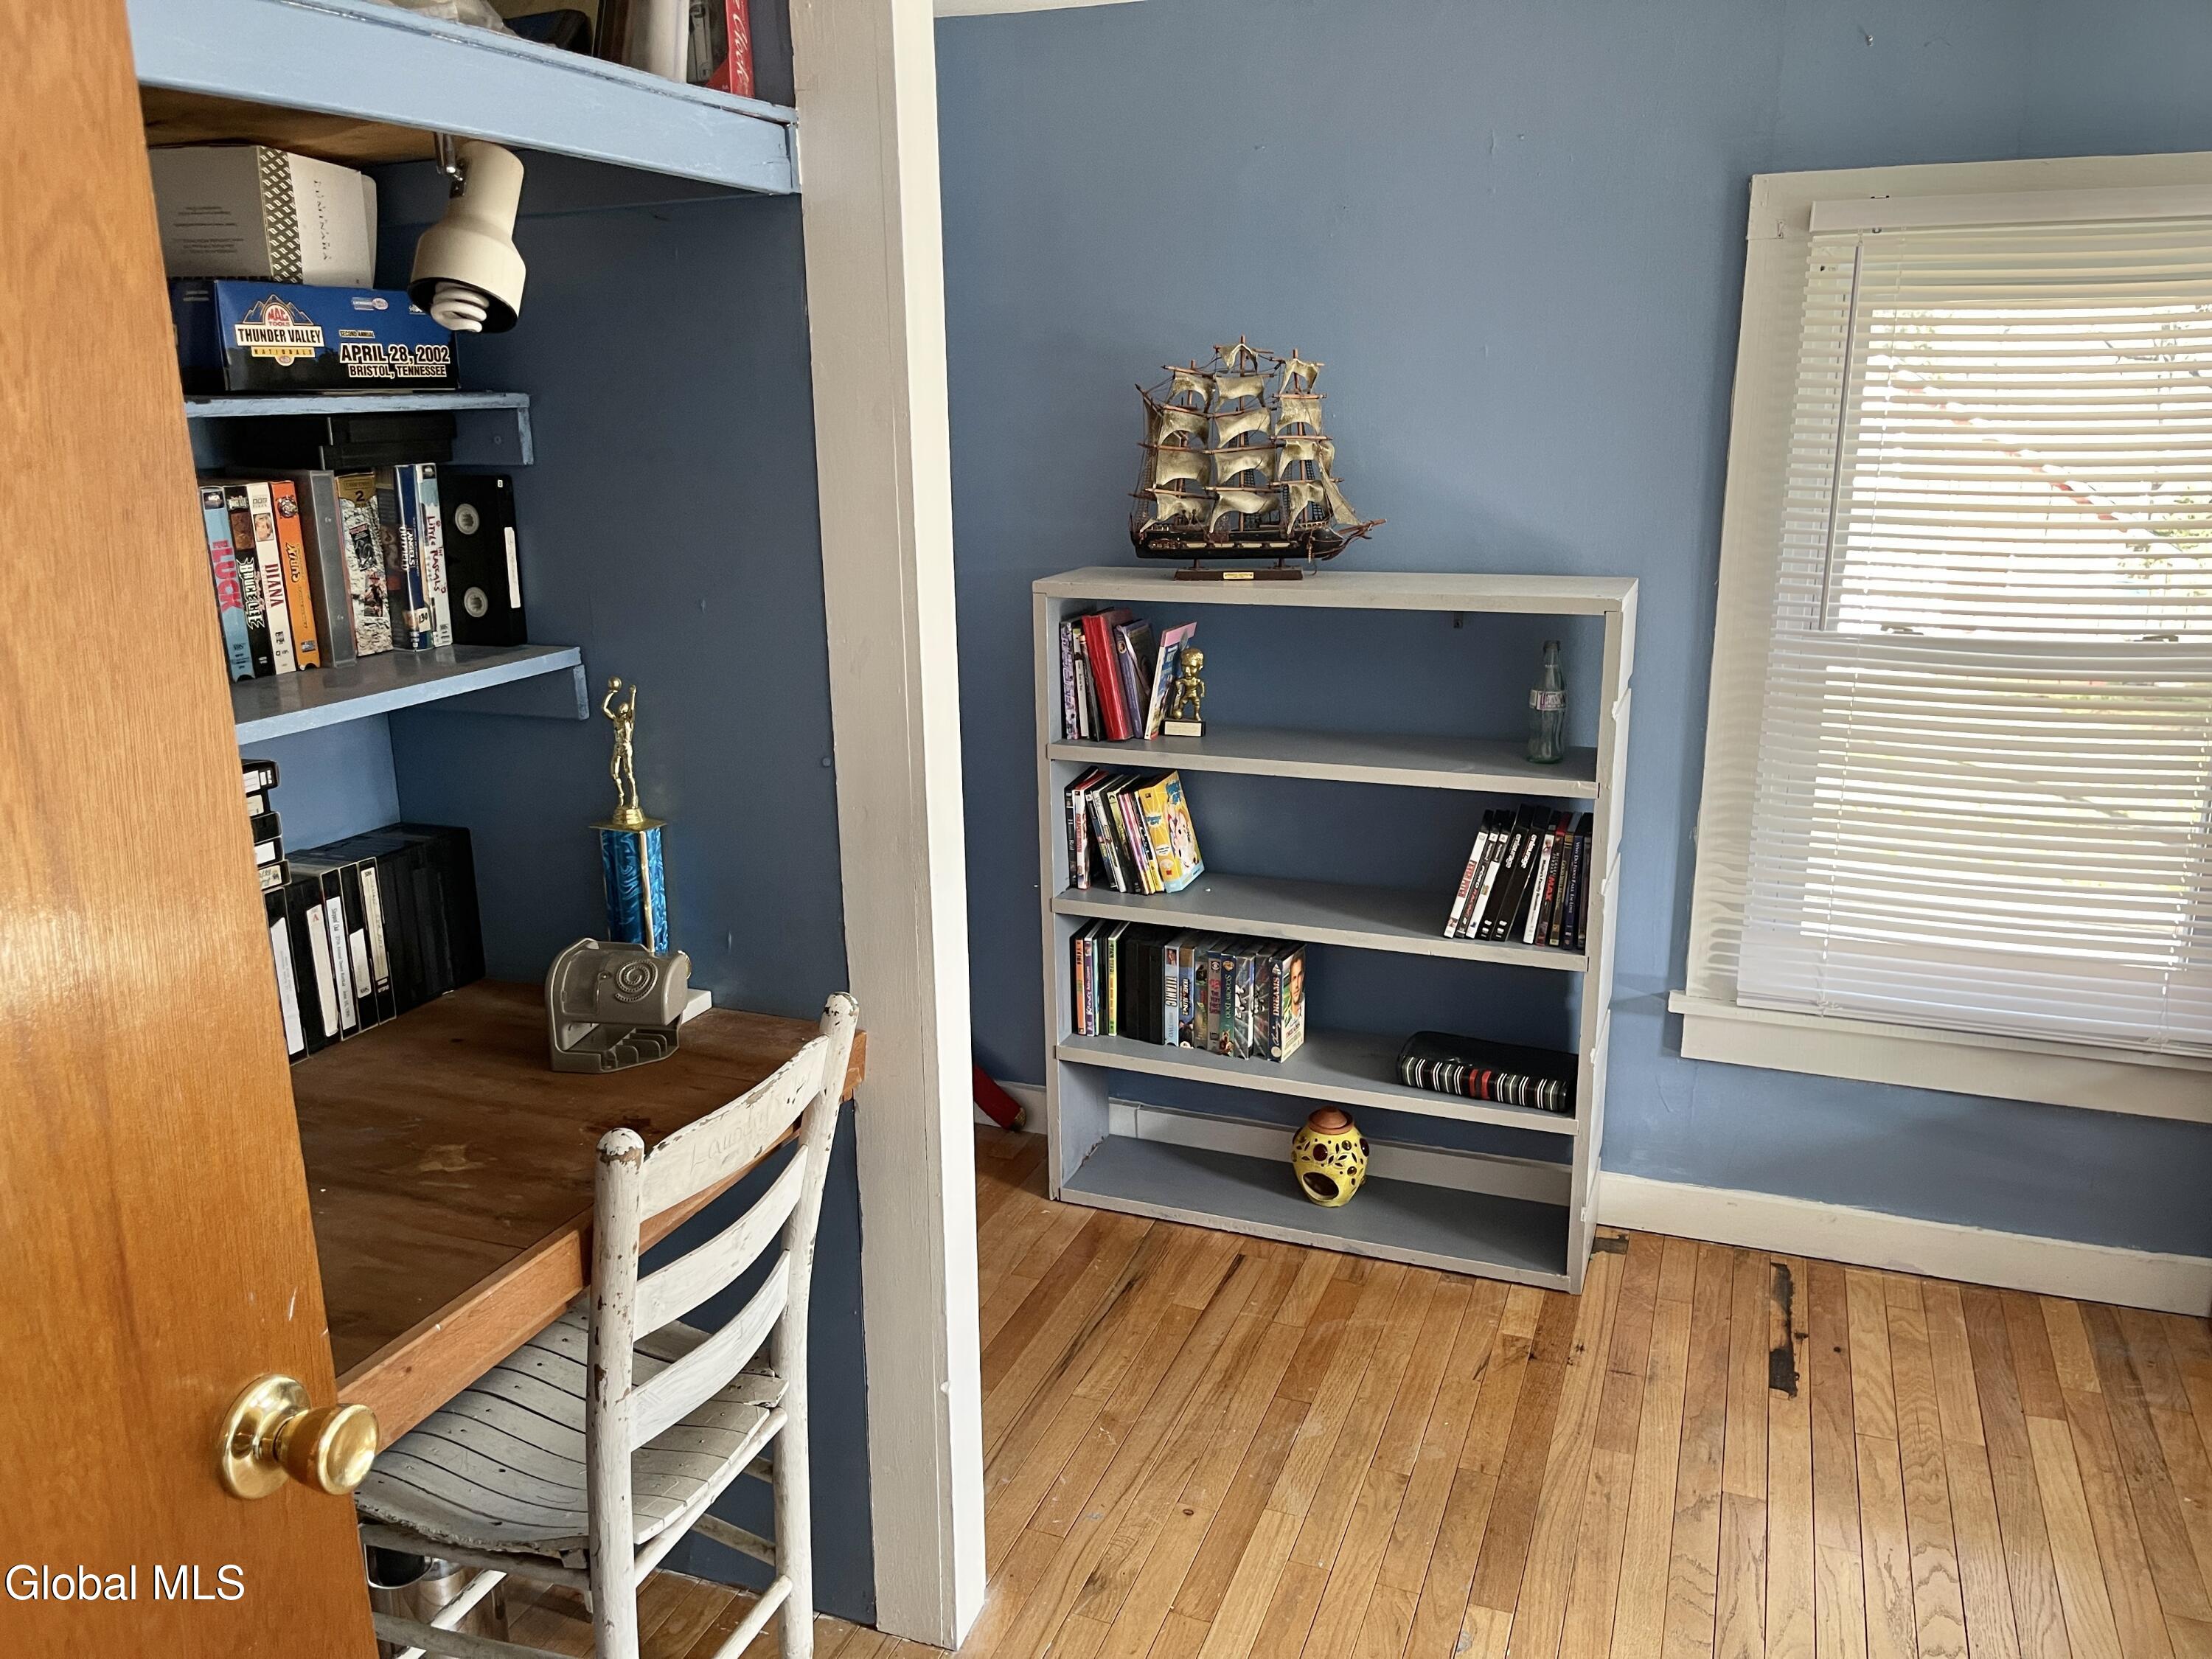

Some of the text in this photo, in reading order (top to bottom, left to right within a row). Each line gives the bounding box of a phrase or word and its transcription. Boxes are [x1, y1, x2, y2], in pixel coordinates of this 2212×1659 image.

[733, 13, 750, 83] Clock
[268, 307, 288, 321] MAC
[237, 328, 321, 344] THUNDER VALLEY
[341, 344, 450, 364] APRIL 28, 2002
[349, 365, 447, 379] BRISTOL, TENNESSEE
[399, 526, 410, 571] OUTFIELD
[406, 531, 415, 566] ANGELS
[212, 547, 243, 613] LUCK
[239, 563, 257, 601] BRUCE
[265, 563, 284, 608] DIANA
[1506, 834, 1522, 869] entourage
[1521, 834, 1537, 869] entourage
[1475, 865, 1485, 888] FORD
[1545, 876, 1555, 902] MAX
[1166, 976, 1177, 1007] TITANIC
